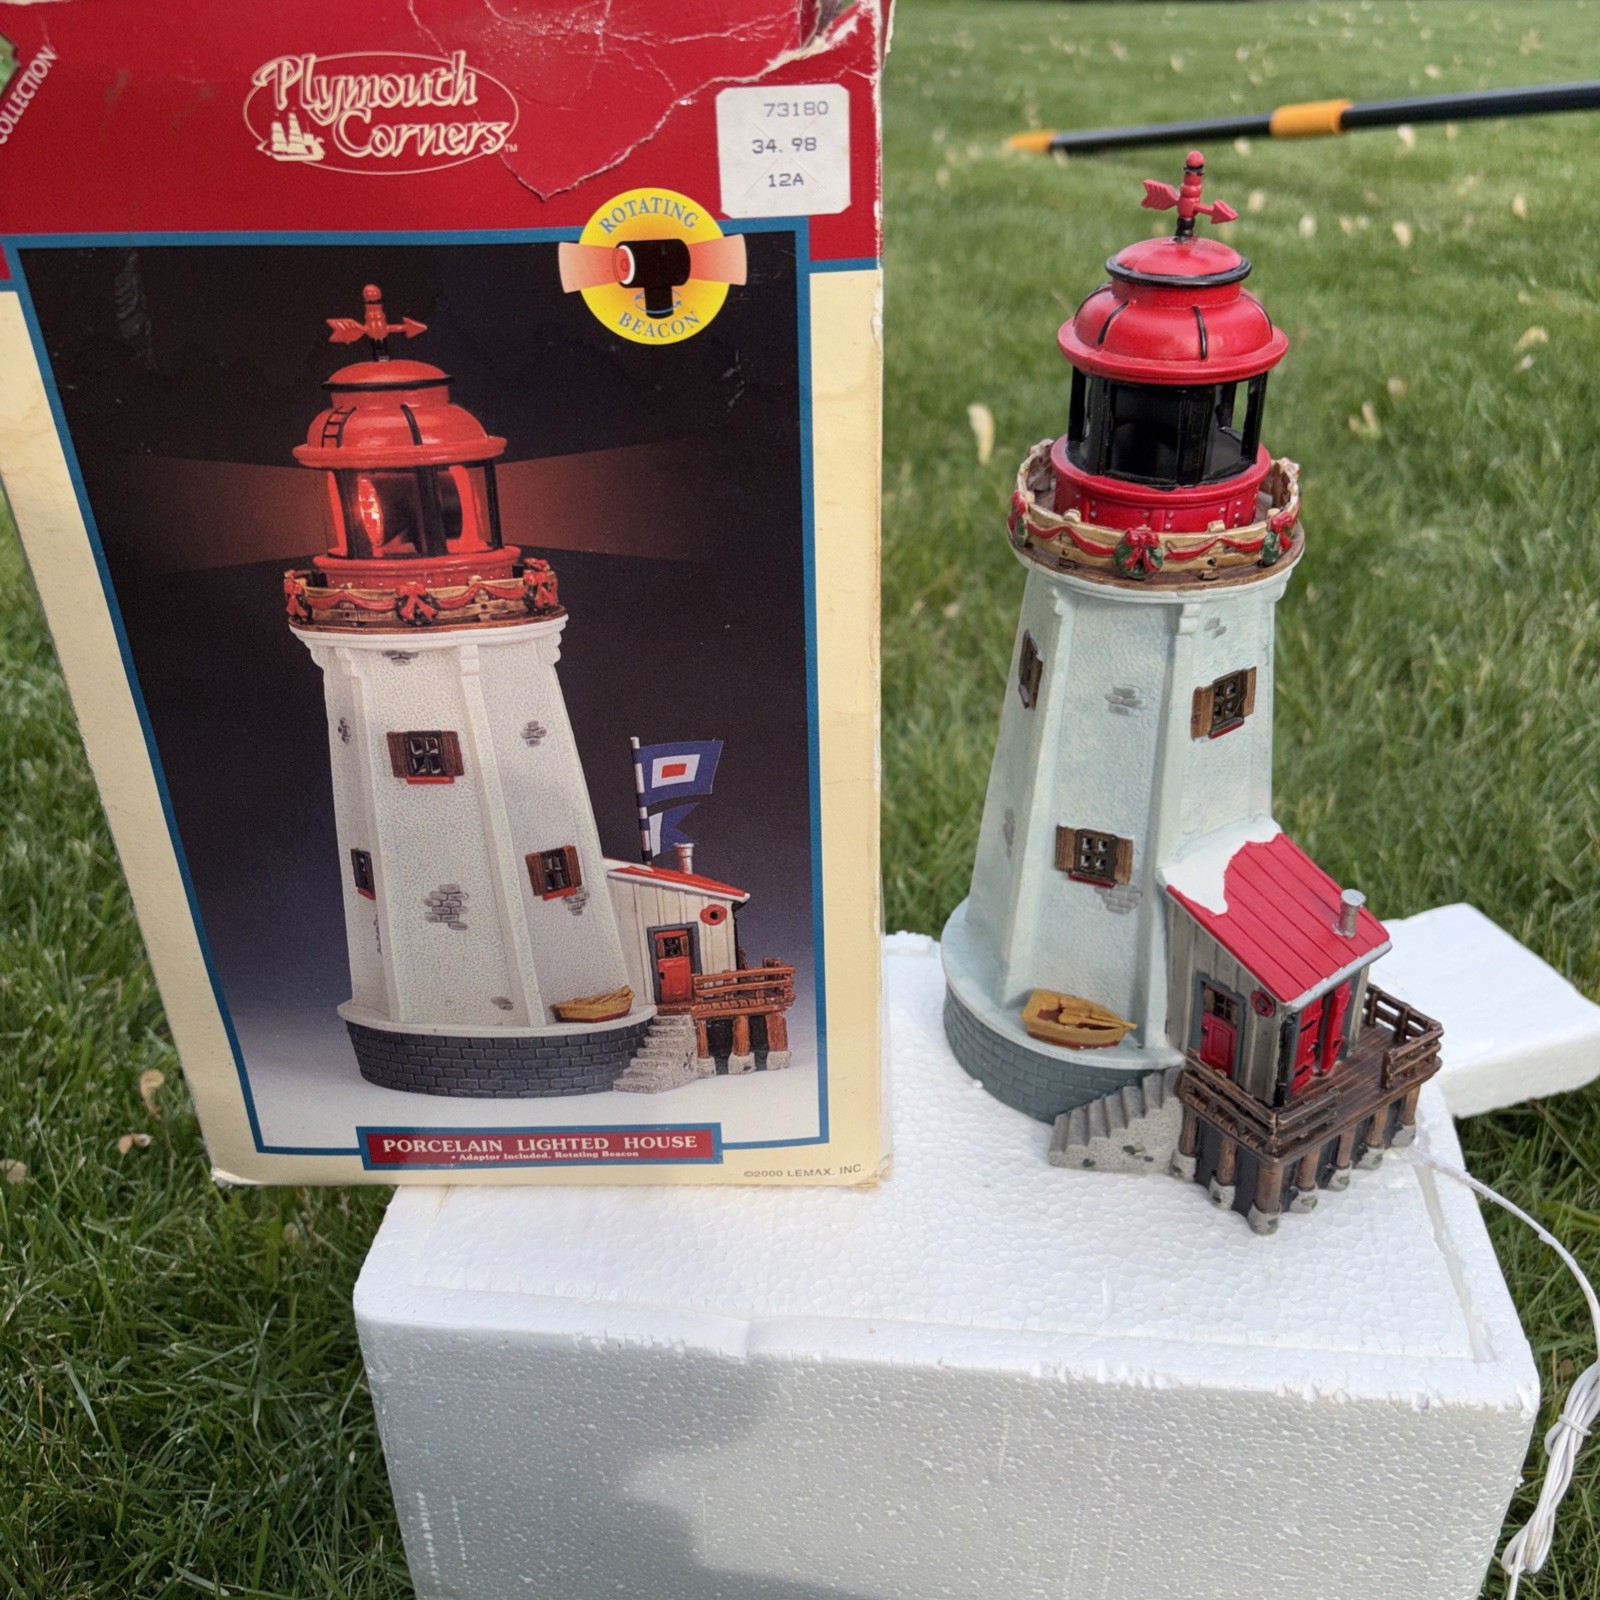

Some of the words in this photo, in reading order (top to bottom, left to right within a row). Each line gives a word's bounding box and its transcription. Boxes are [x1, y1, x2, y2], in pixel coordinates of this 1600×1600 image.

[252, 50, 479, 126] Plymouth
[764, 101, 829, 117] 73180
[332, 106, 510, 158] Corners
[768, 173, 804, 187] 12A
[599, 197, 699, 234] ROTATING
[618, 310, 700, 338] BEACON
[383, 1139, 503, 1153] PORCELAIN
[518, 1137, 609, 1151] LIGHTED
[623, 1136, 698, 1149] HOUSE
[459, 1153, 501, 1161] Adaptor
[554, 1151, 599, 1159] Rotating
[602, 1150, 639, 1158] Beacon
